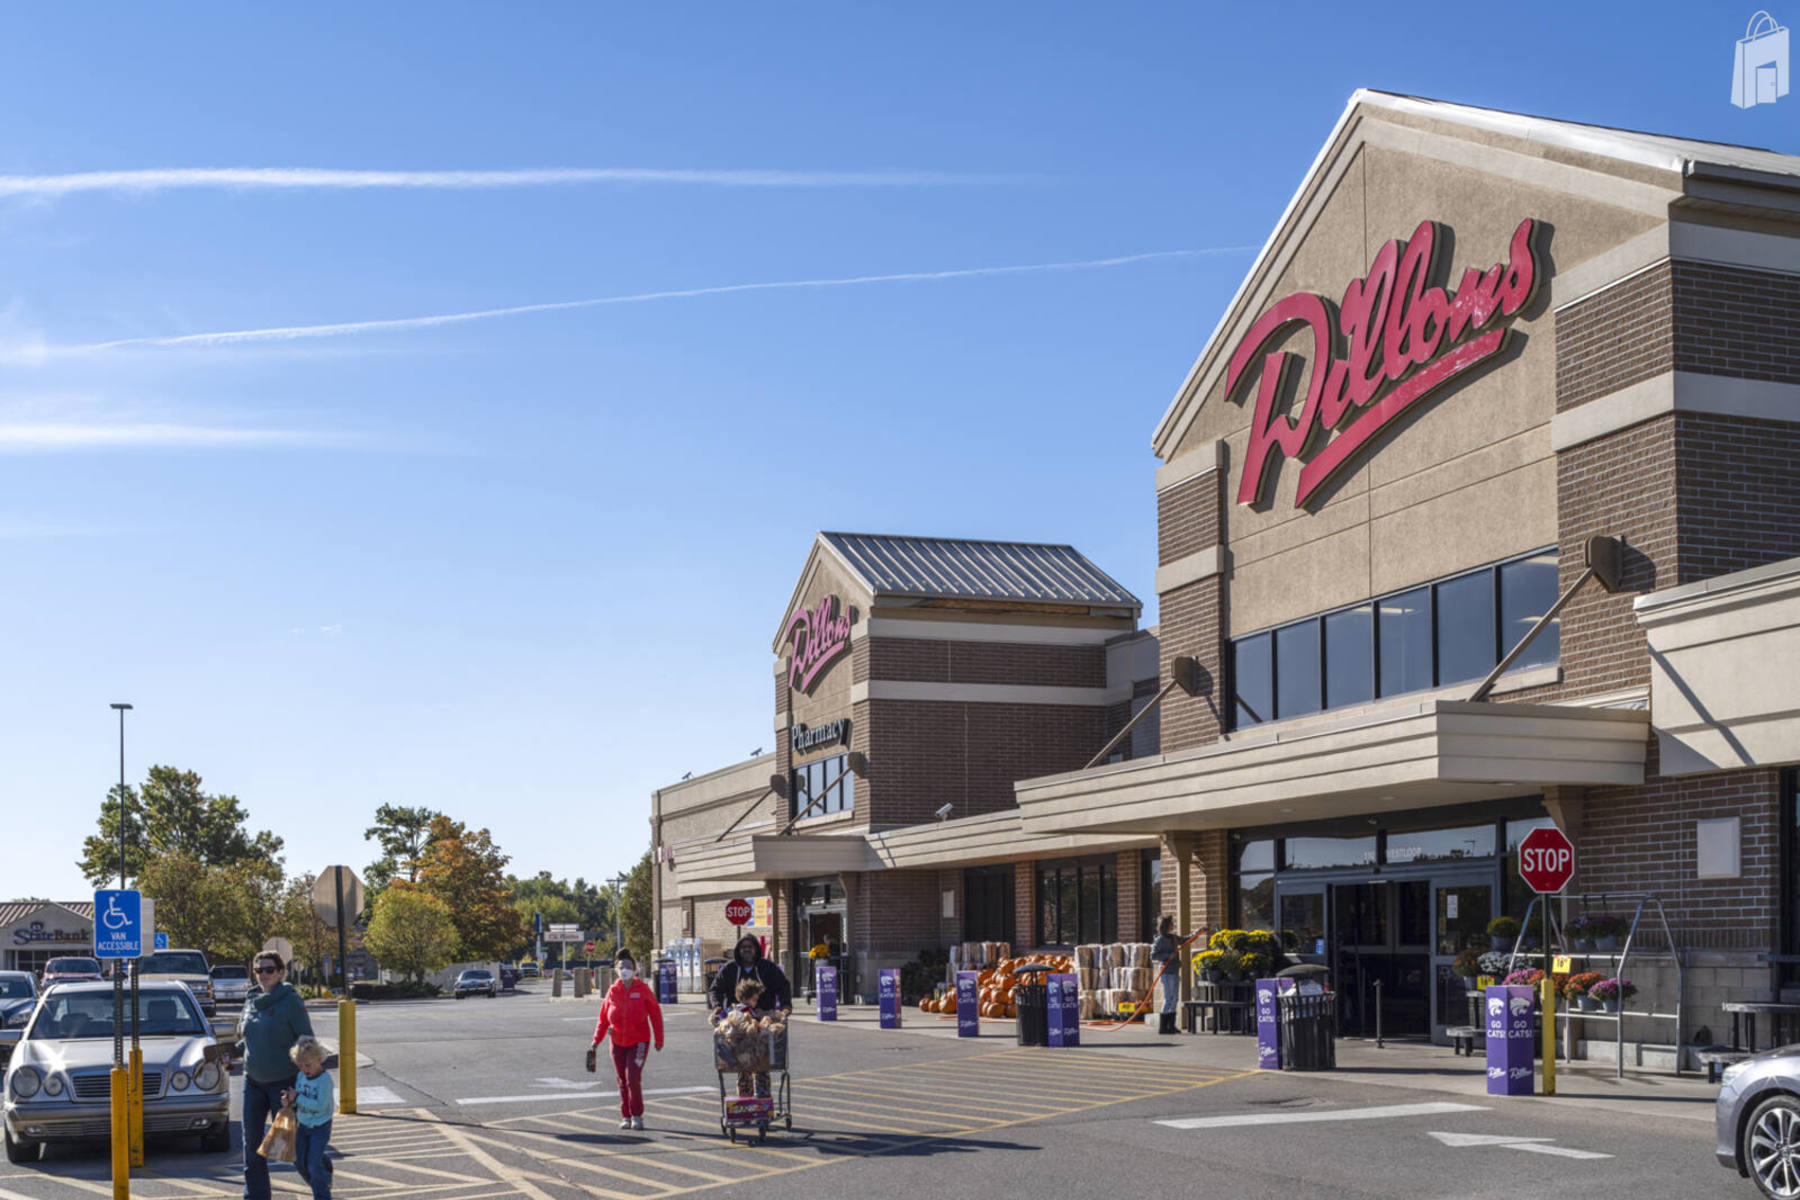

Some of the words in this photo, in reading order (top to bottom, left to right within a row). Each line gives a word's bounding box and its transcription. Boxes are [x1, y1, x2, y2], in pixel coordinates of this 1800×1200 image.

[1224, 218, 1534, 508] Dillons
[786, 594, 850, 691] Dillons
[792, 718, 846, 750] Pharmacy
[1523, 848, 1570, 872] STOP
[727, 907, 750, 917] STOP
[110, 932, 126, 940] VAN
[98, 942, 139, 951] ACCESSIBLE
[1261, 1007, 1271, 1015] GO
[1491, 1020, 1502, 1028] GO
[1514, 1020, 1527, 1029] GO
[1487, 1029, 1506, 1038] CATS!
[1508, 1030, 1532, 1038] CATS!
